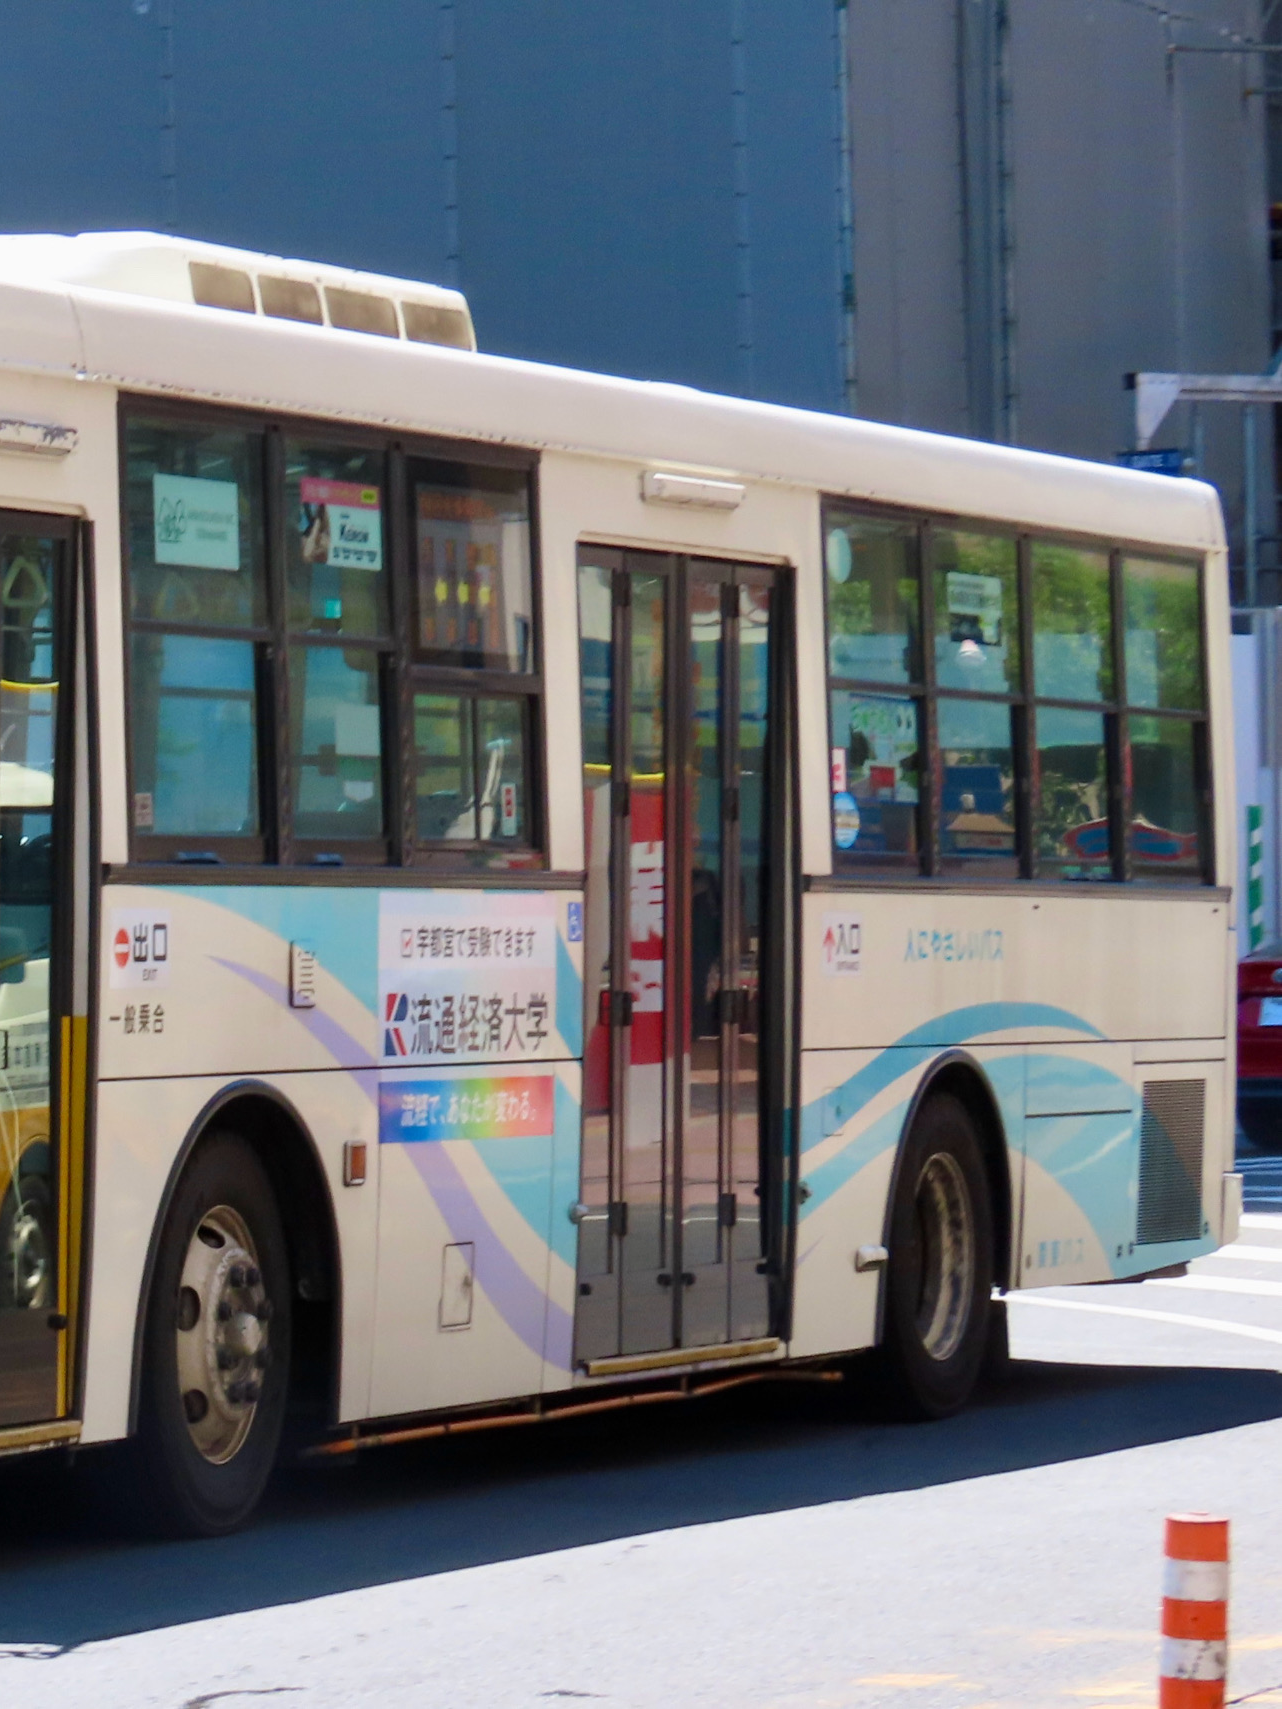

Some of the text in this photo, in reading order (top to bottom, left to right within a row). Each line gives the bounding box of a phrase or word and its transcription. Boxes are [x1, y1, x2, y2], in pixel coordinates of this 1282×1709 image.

[133, 922, 167, 962] 出口
[416, 925, 536, 958] 宇都宮で受験できます
[835, 923, 861, 955] 入口
[903, 928, 1004, 962] 人にやさしいバス
[109, 1003, 164, 1034] 一般乗合
[409, 992, 548, 1055] 流通経済大学
